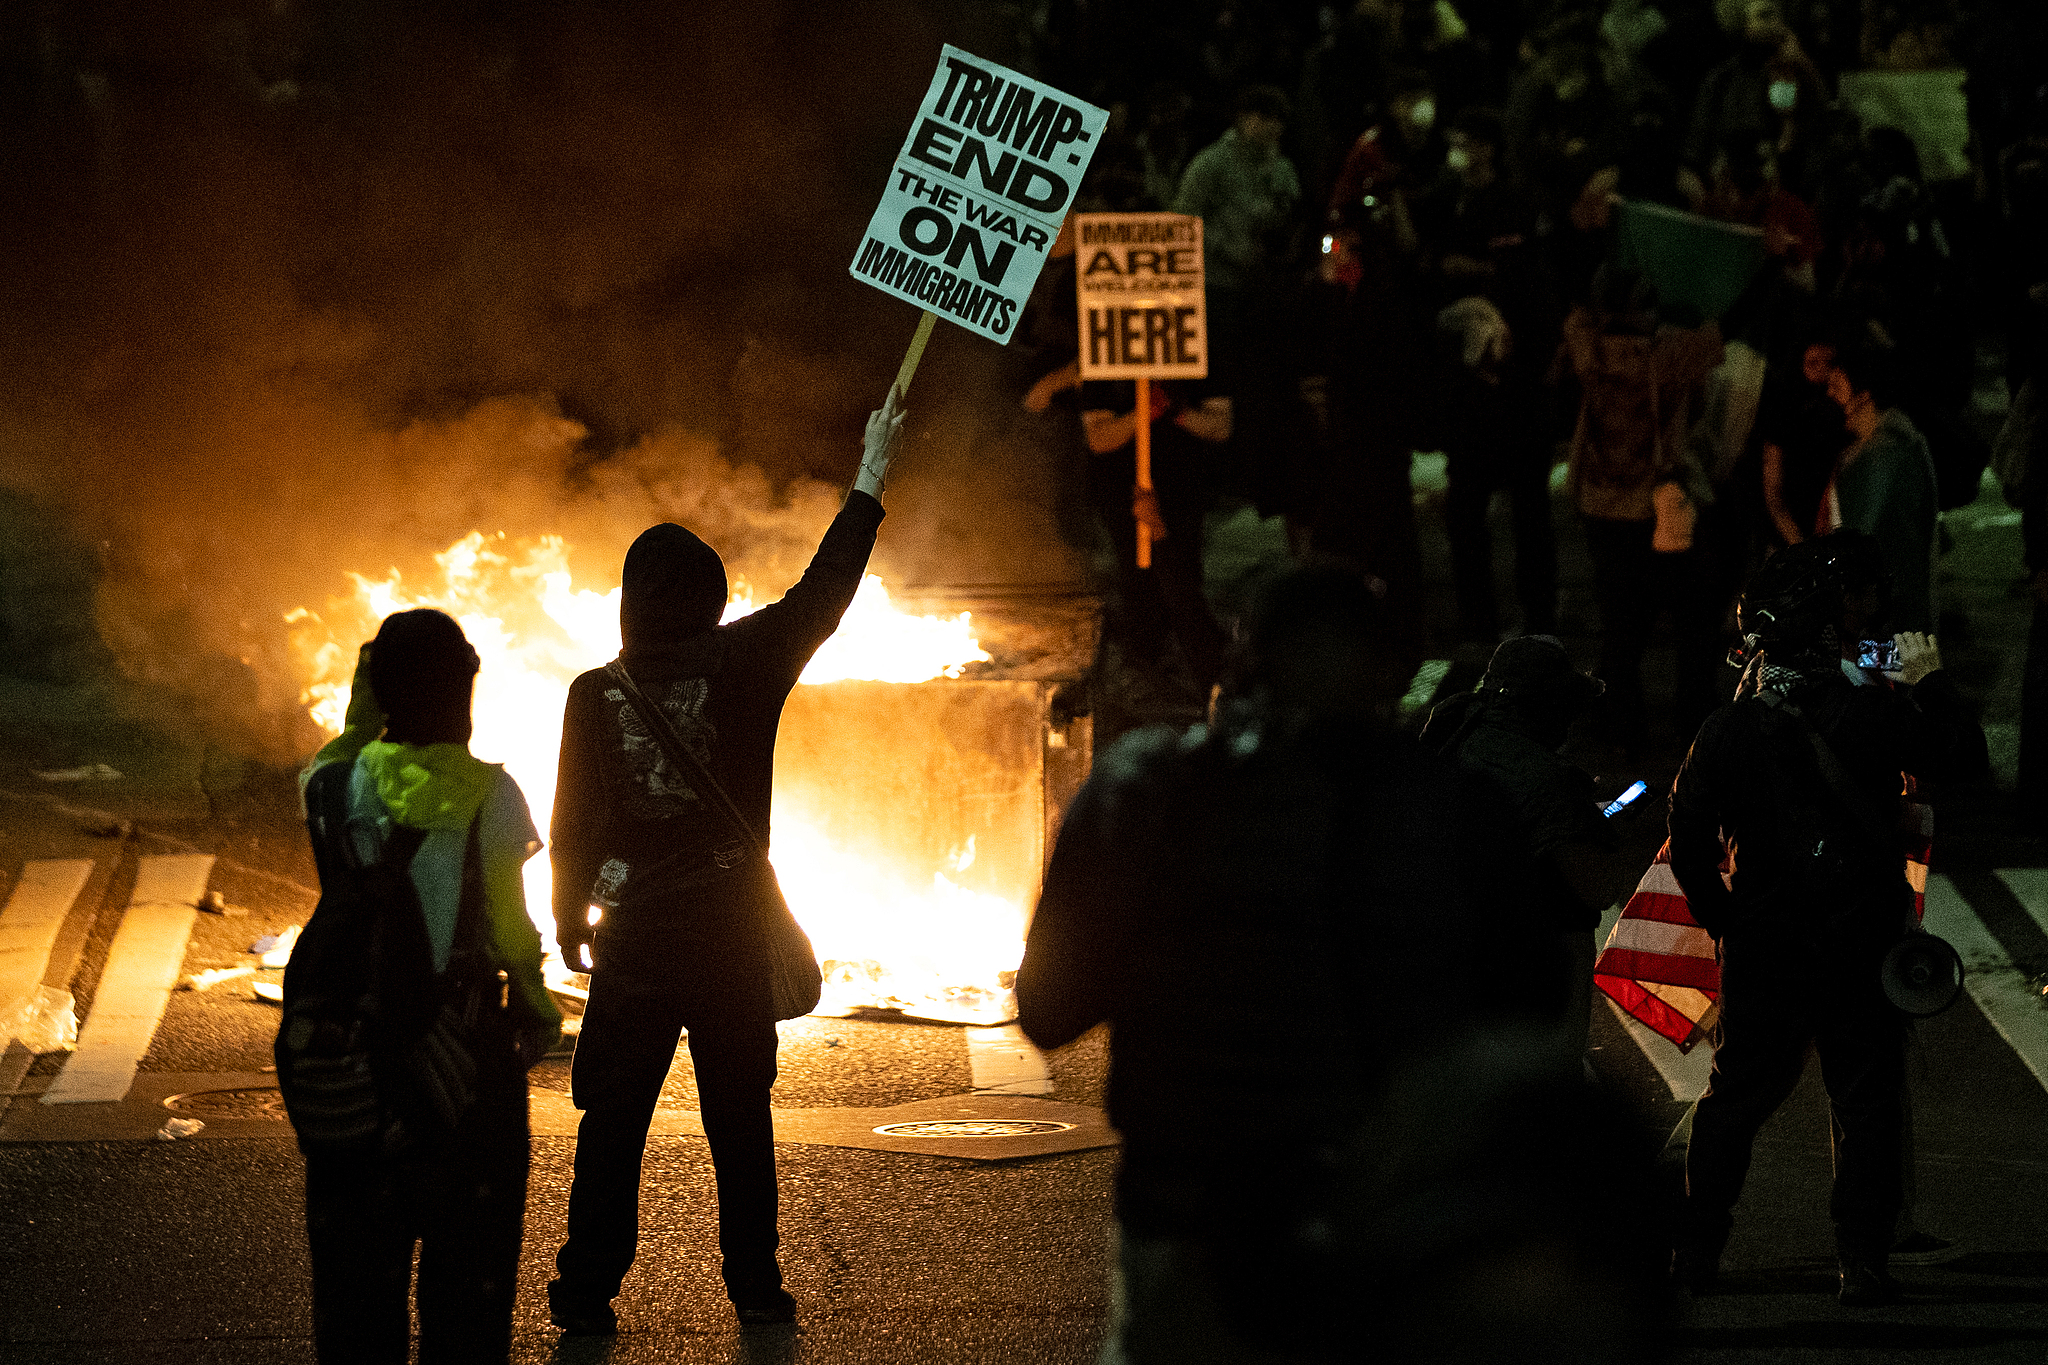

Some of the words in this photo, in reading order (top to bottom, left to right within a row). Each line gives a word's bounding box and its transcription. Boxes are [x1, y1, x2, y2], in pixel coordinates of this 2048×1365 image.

[933, 57, 1091, 166] TRUMP:
[908, 117, 1069, 213] END
[898, 168, 963, 215] THE
[966, 198, 1049, 252] WAR
[899, 206, 1017, 287] ON
[855, 237, 1016, 335] IMMIGRANTS
[1085, 247, 1198, 276] ARE
[1089, 307, 1197, 365] HERE
